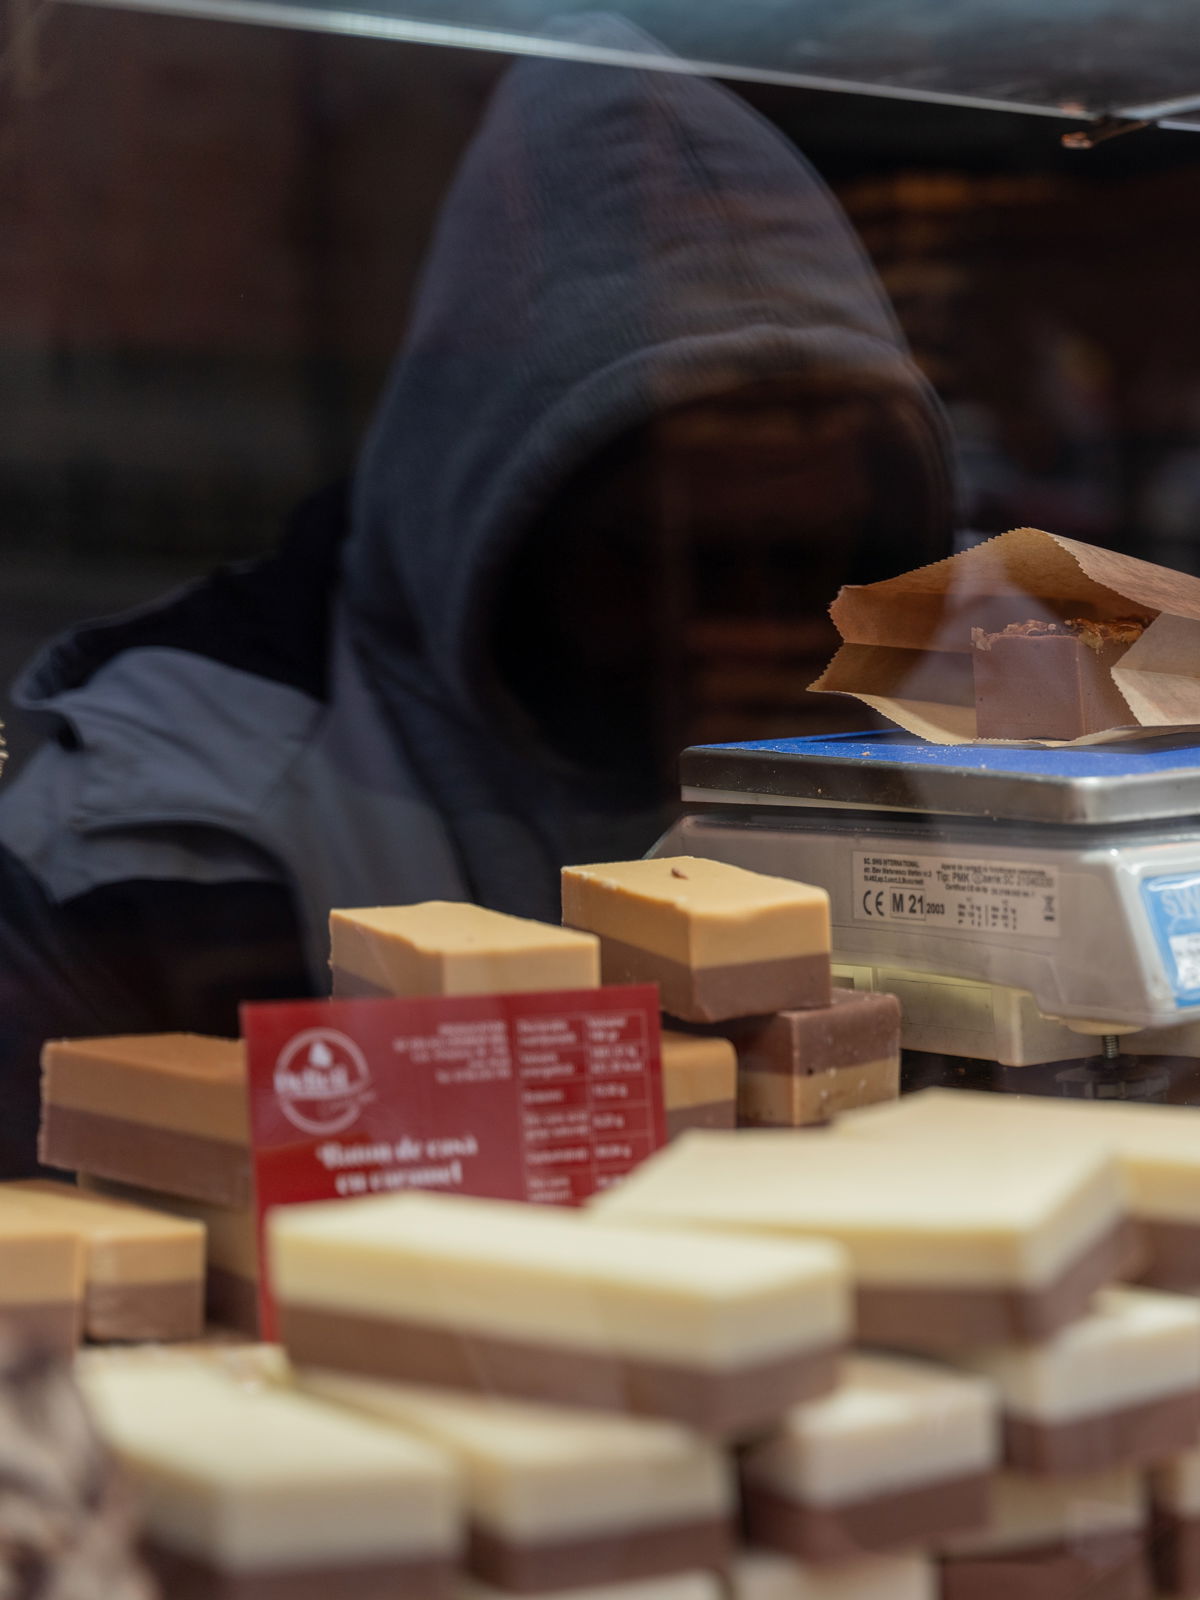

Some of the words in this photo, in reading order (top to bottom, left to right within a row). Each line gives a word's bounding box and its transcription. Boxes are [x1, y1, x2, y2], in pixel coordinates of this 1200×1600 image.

[863, 890, 885, 917] CE
[892, 893, 904, 913] M
[908, 894, 924, 914] 21
[926, 902, 945, 915] 2003
